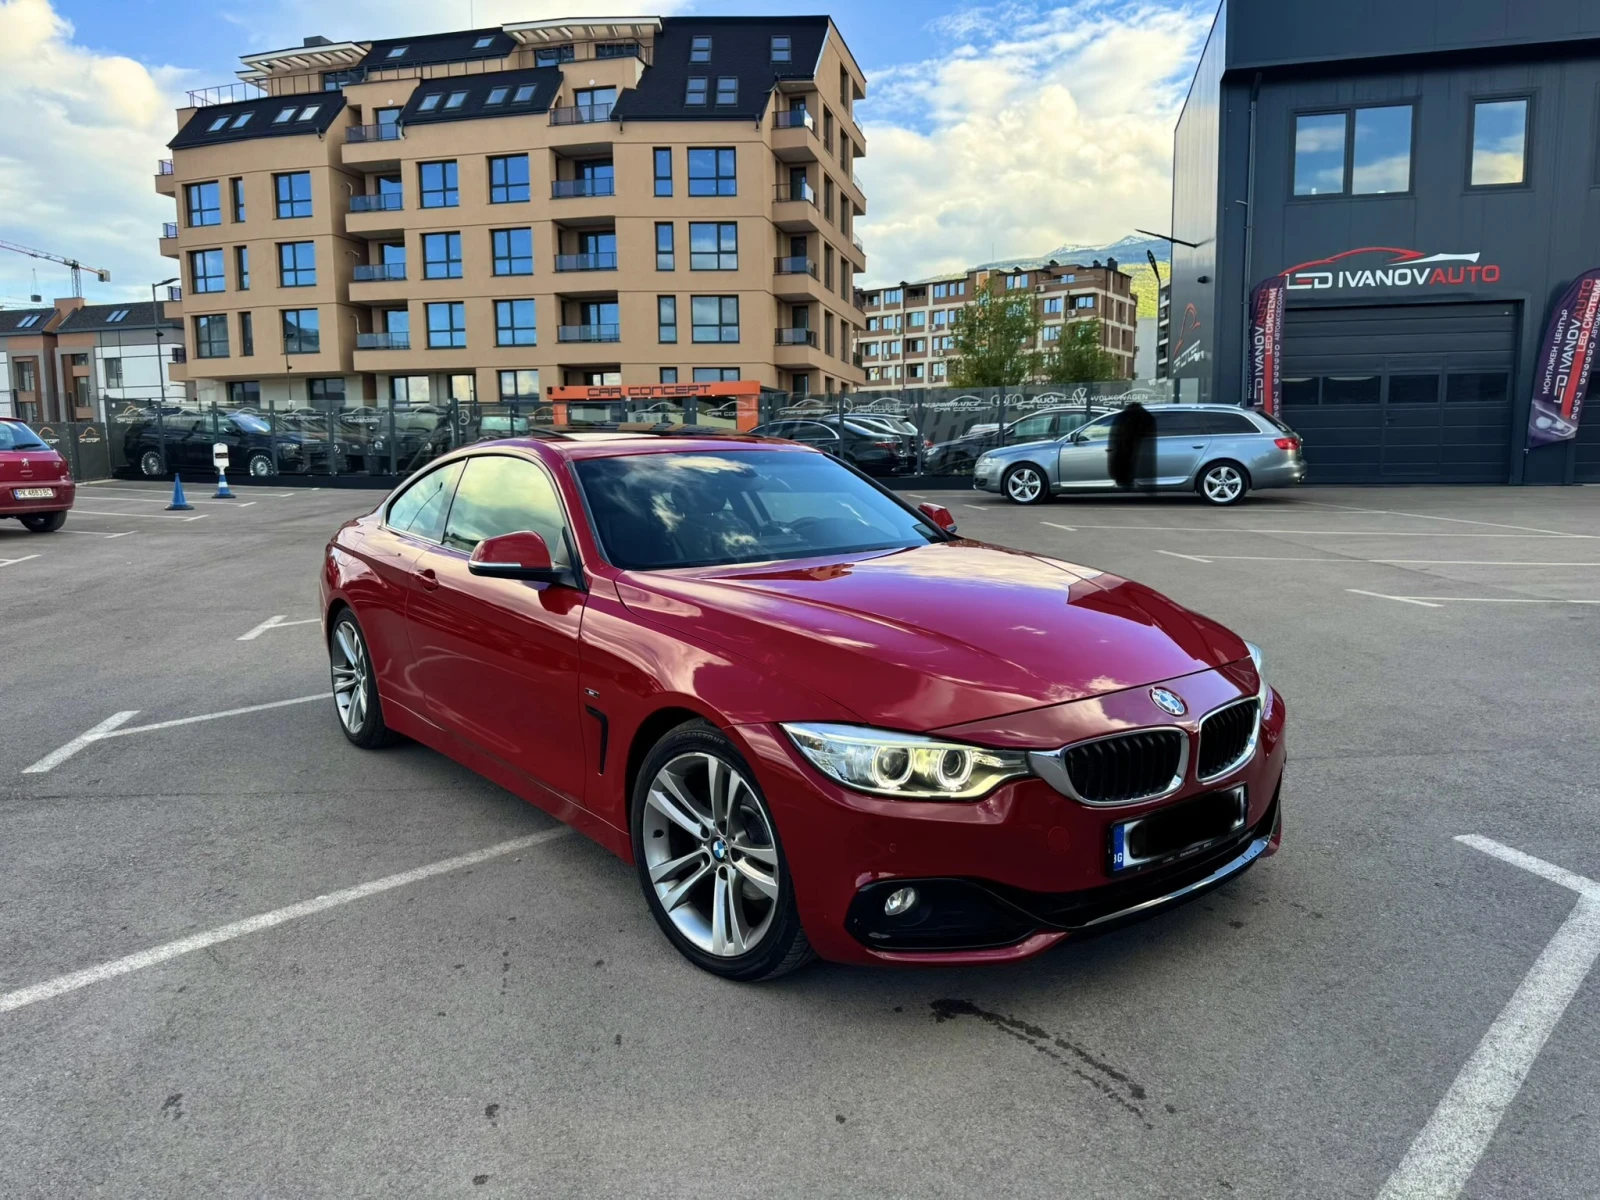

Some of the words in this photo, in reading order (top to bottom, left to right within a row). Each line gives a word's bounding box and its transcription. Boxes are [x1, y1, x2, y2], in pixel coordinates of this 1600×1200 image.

[1285, 271, 1333, 290] LED
[1265, 287, 1278, 334] СИСТЕМИ
[1265, 335, 1273, 355] LED
[1542, 346, 1559, 395] МОНТАЖЕН
[1553, 309, 1568, 344] ЦЕНТЪР
[1576, 330, 1590, 352] LED
[587, 387, 622, 397] CAR
[628, 384, 711, 396] CONCEPT
[1553, 374, 1568, 404] LED
